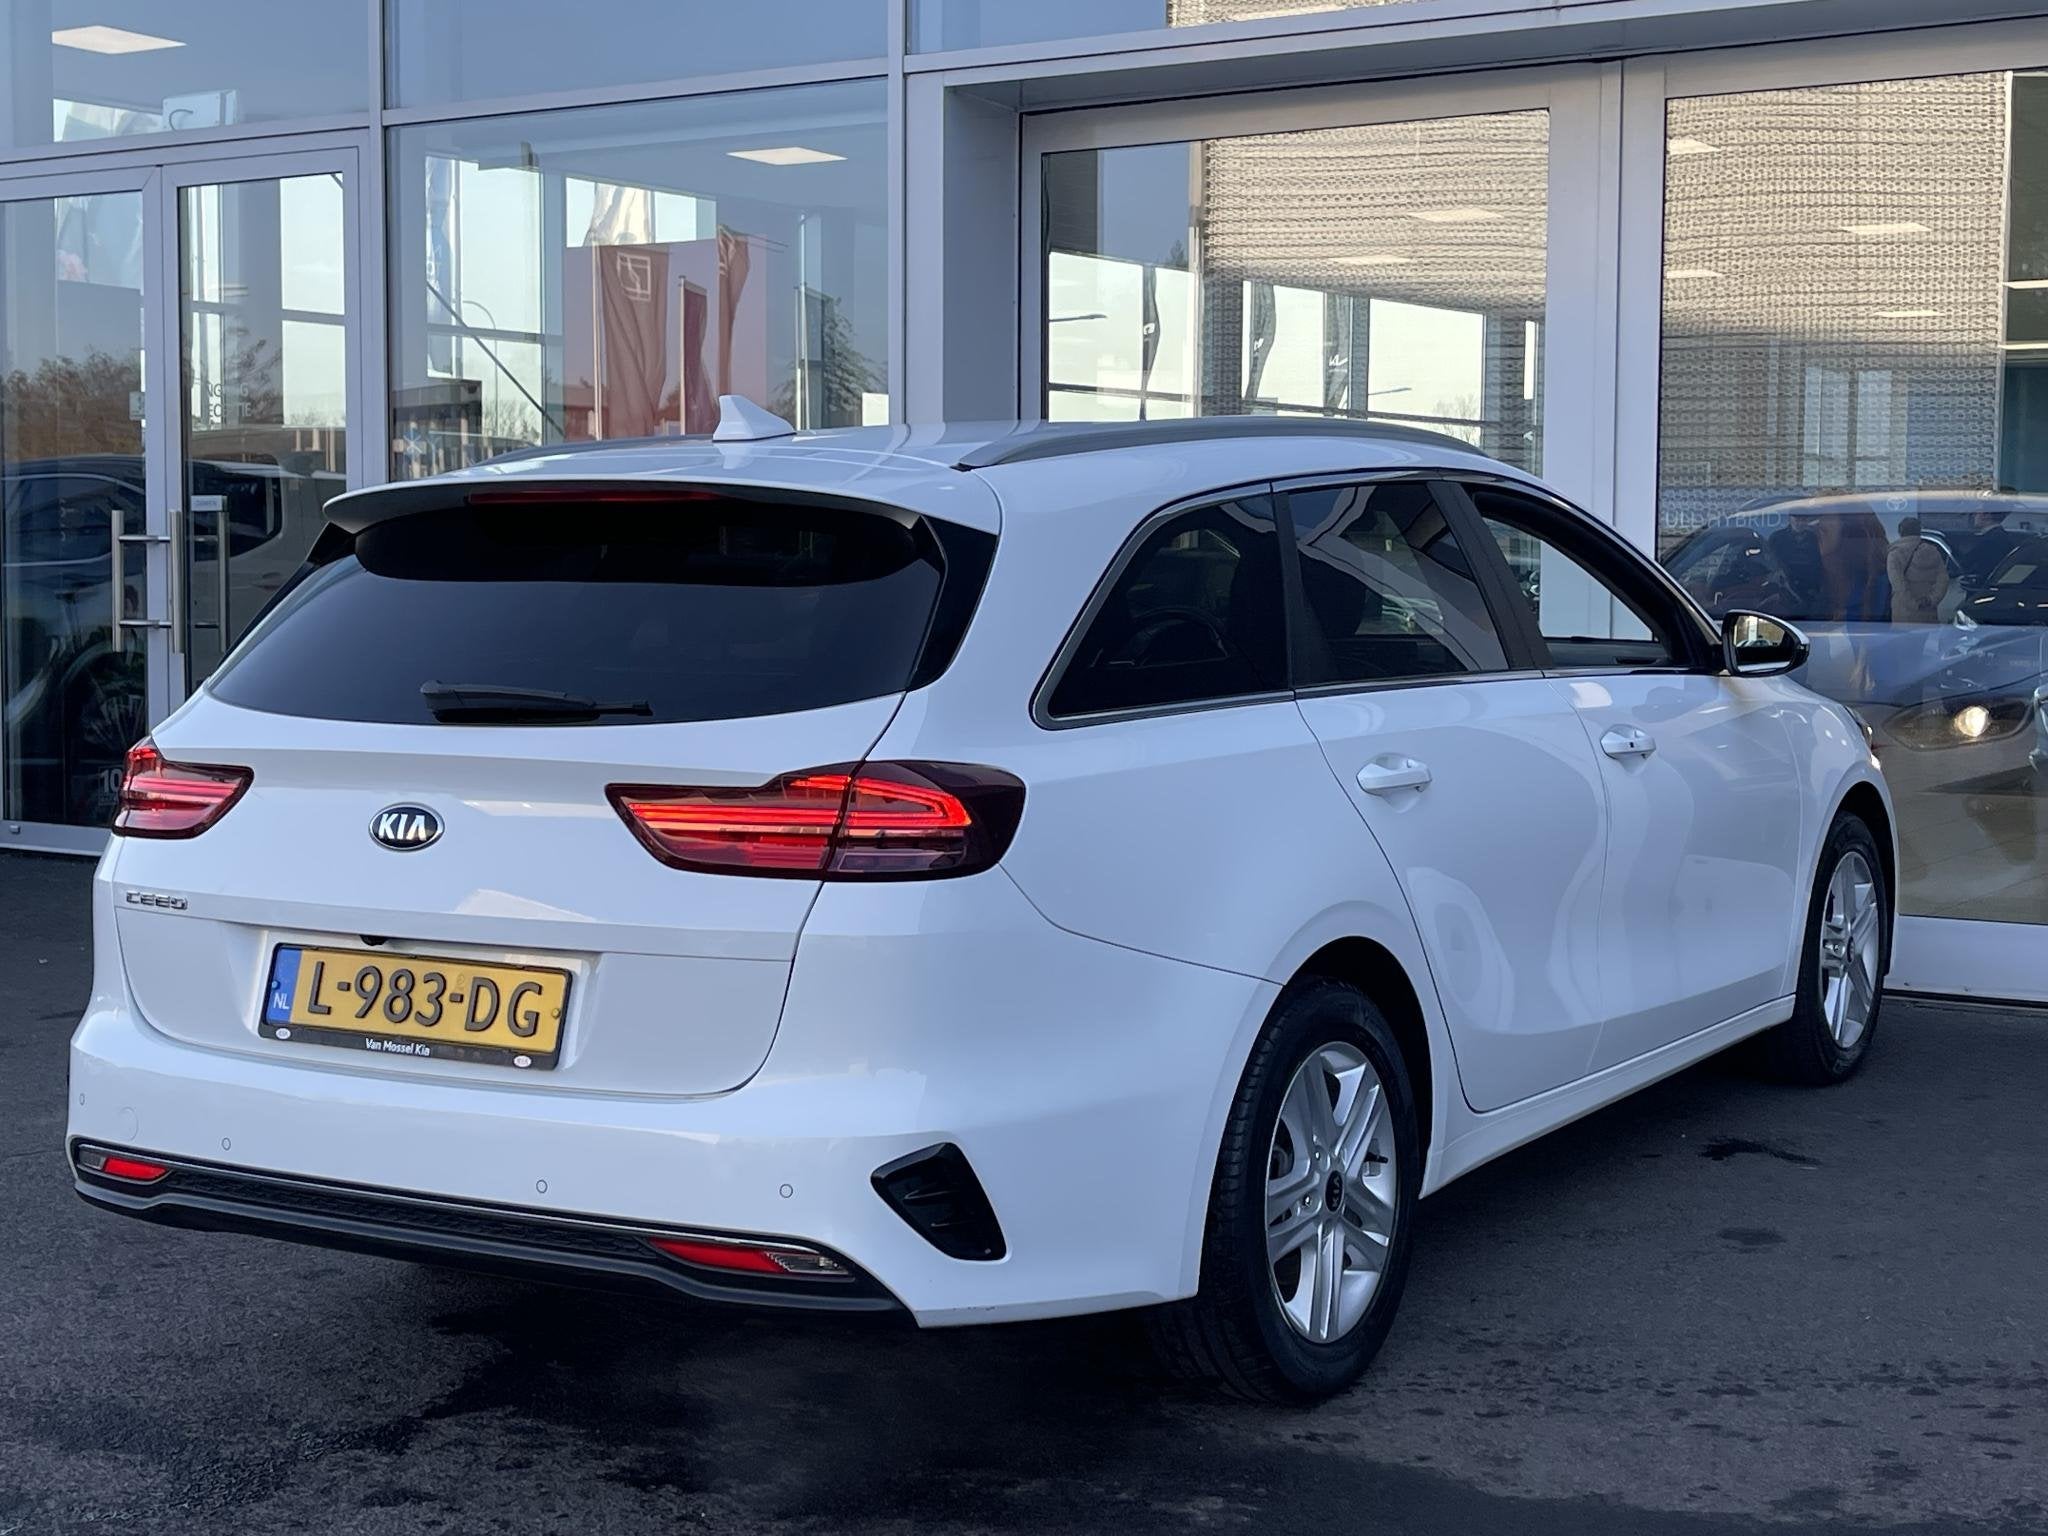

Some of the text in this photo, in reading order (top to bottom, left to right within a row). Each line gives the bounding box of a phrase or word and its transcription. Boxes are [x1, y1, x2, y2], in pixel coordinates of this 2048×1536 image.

[378, 813, 427, 841] KIA
[273, 993, 290, 1010] NL
[308, 960, 543, 1038] L-983-DG
[366, 1037, 431, 1057] Van Mossel Kia
